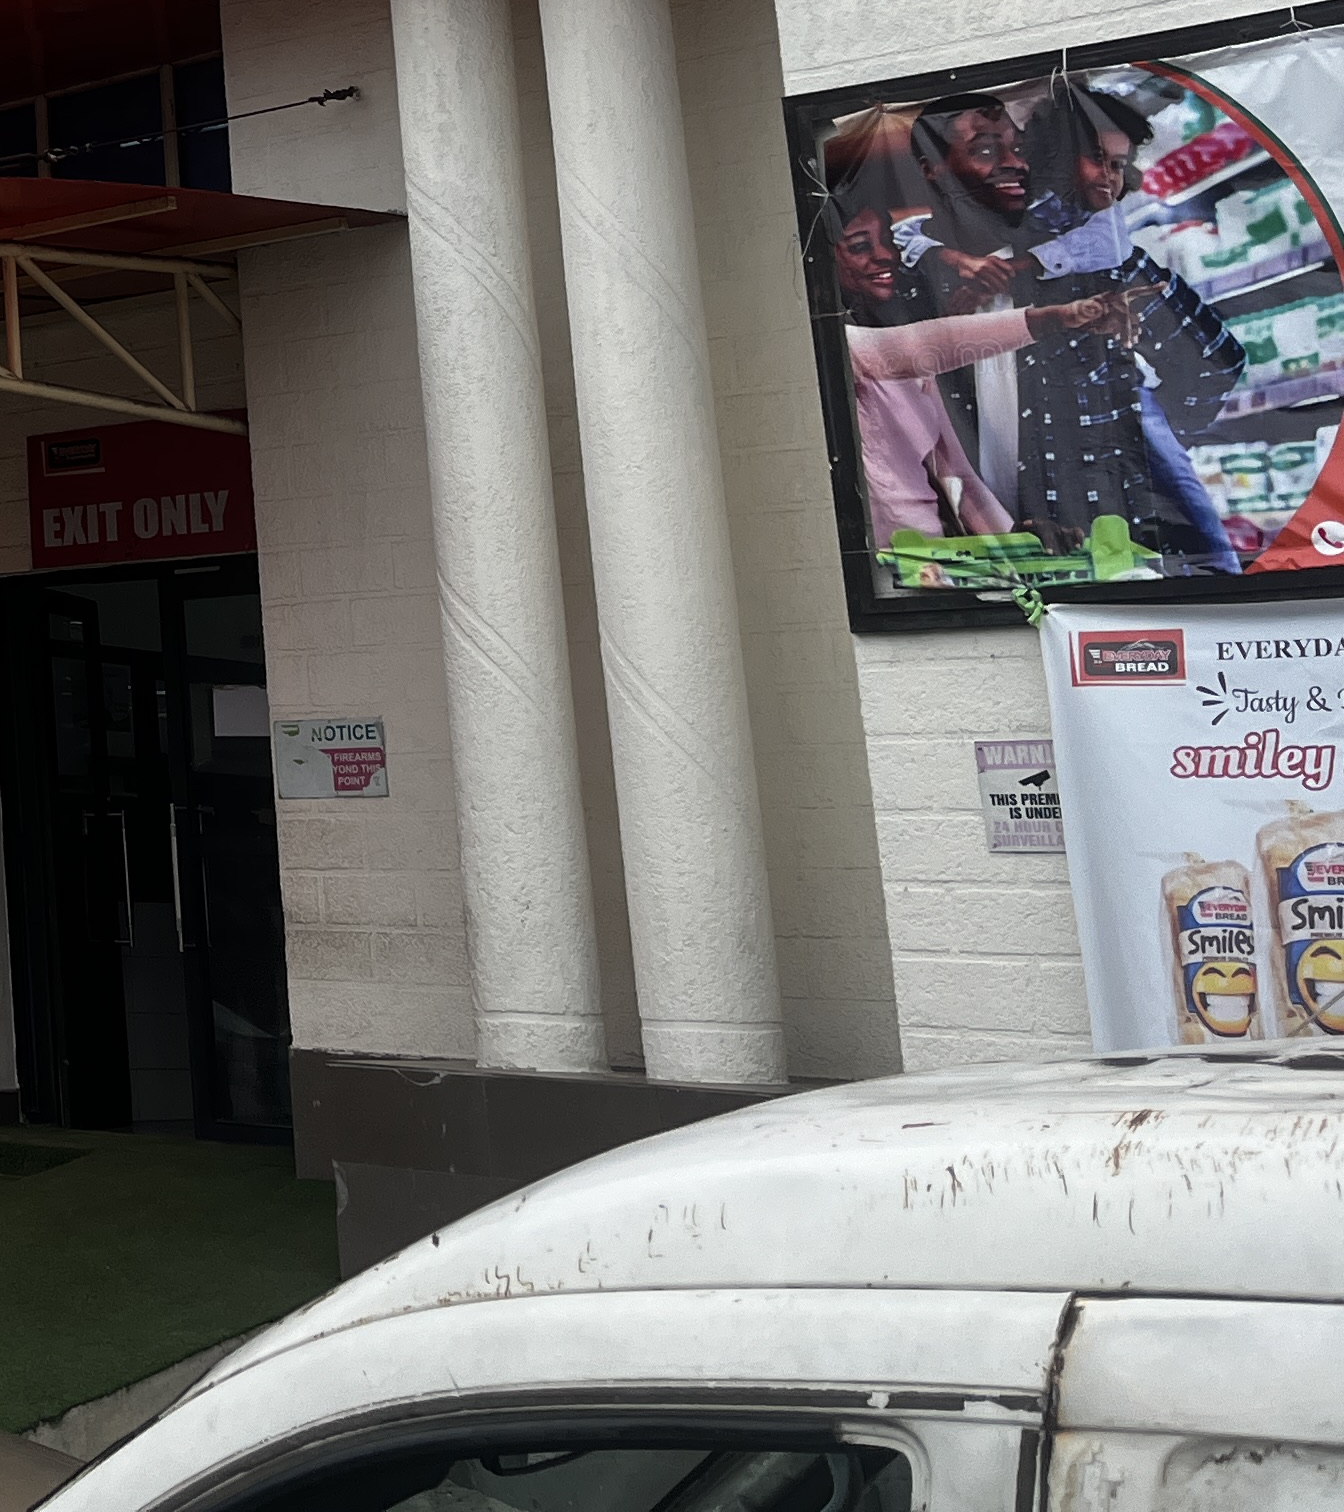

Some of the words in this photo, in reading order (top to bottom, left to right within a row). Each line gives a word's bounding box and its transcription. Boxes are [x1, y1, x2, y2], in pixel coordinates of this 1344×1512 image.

[42, 501, 124, 548] EXIT
[132, 489, 230, 539] ONLY
[1102, 649, 1172, 662] EVERYDAY
[1115, 662, 1170, 673] BREAD
[1231, 687, 1300, 724] Tasty
[1305, 685, 1333, 712] &
[311, 724, 377, 742] NOTICE
[334, 752, 382, 763] FIREARMS
[1170, 728, 1336, 791] smiley
[337, 776, 366, 786] POINT
[989, 794, 1018, 806] THIS
[1009, 807, 1023, 820] IS
[993, 821, 1011, 834] 24
[1014, 821, 1052, 834] HOUR
[1187, 929, 1255, 956] Smiles
